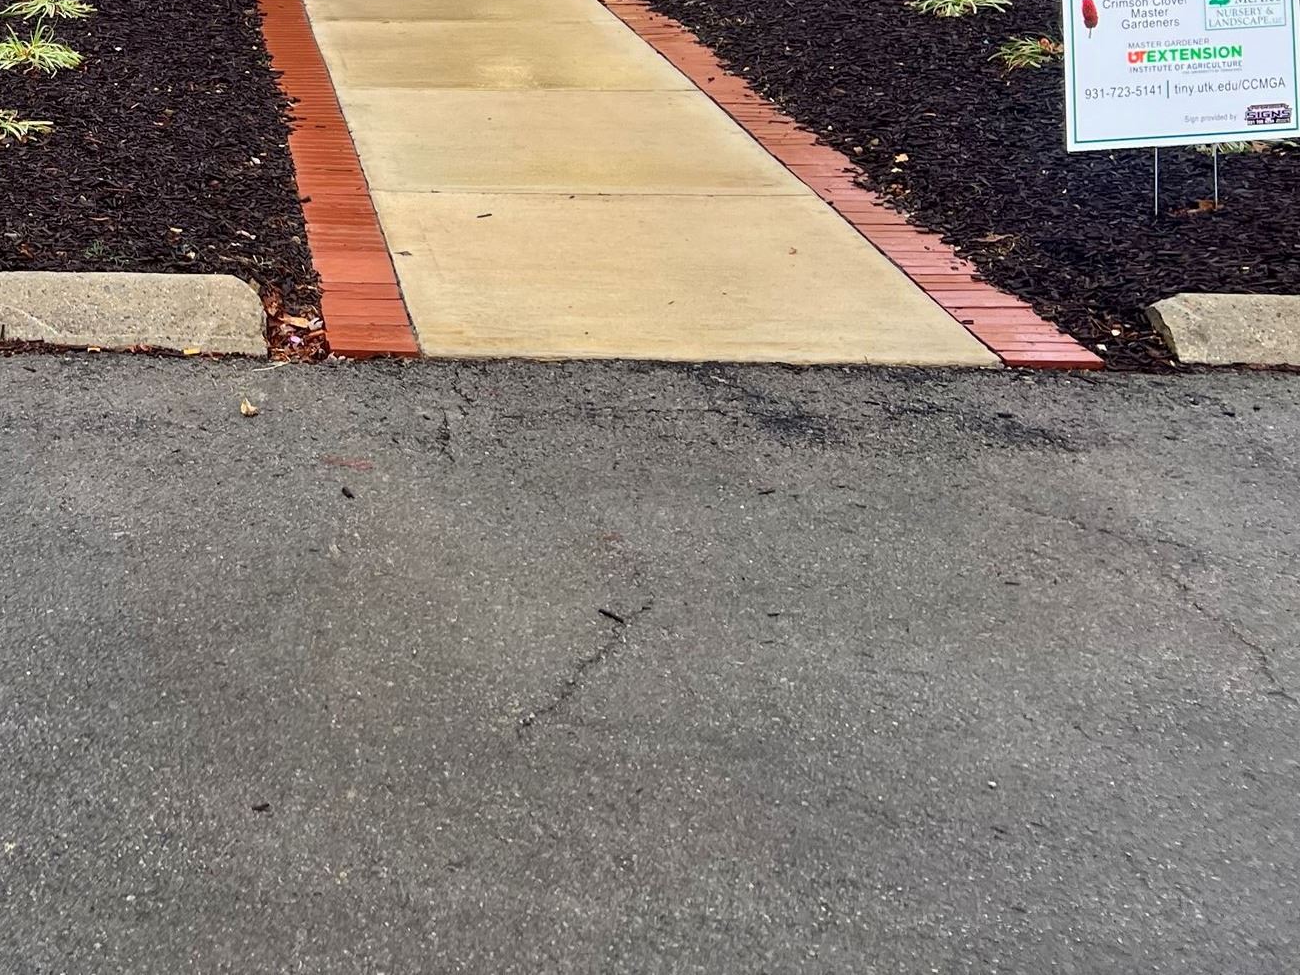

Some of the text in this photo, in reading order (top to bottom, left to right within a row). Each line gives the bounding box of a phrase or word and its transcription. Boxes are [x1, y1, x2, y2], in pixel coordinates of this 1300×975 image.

[1131, 8, 1169, 17] Master
[1216, 7, 1274, 17] NURSERY &
[1121, 17, 1180, 29] Gardeners
[1128, 38, 1209, 49] MASTER GARDENER
[1130, 65, 1172, 73] INSTITUTE
[1187, 60, 1242, 70] AGRICULTURE
[1084, 77, 1286, 99] 931-723-5141 tiny.utk.edu/CCMGA
[1184, 113, 1237, 123] Sign provided by
[1246, 109, 1292, 119] SIGNS
